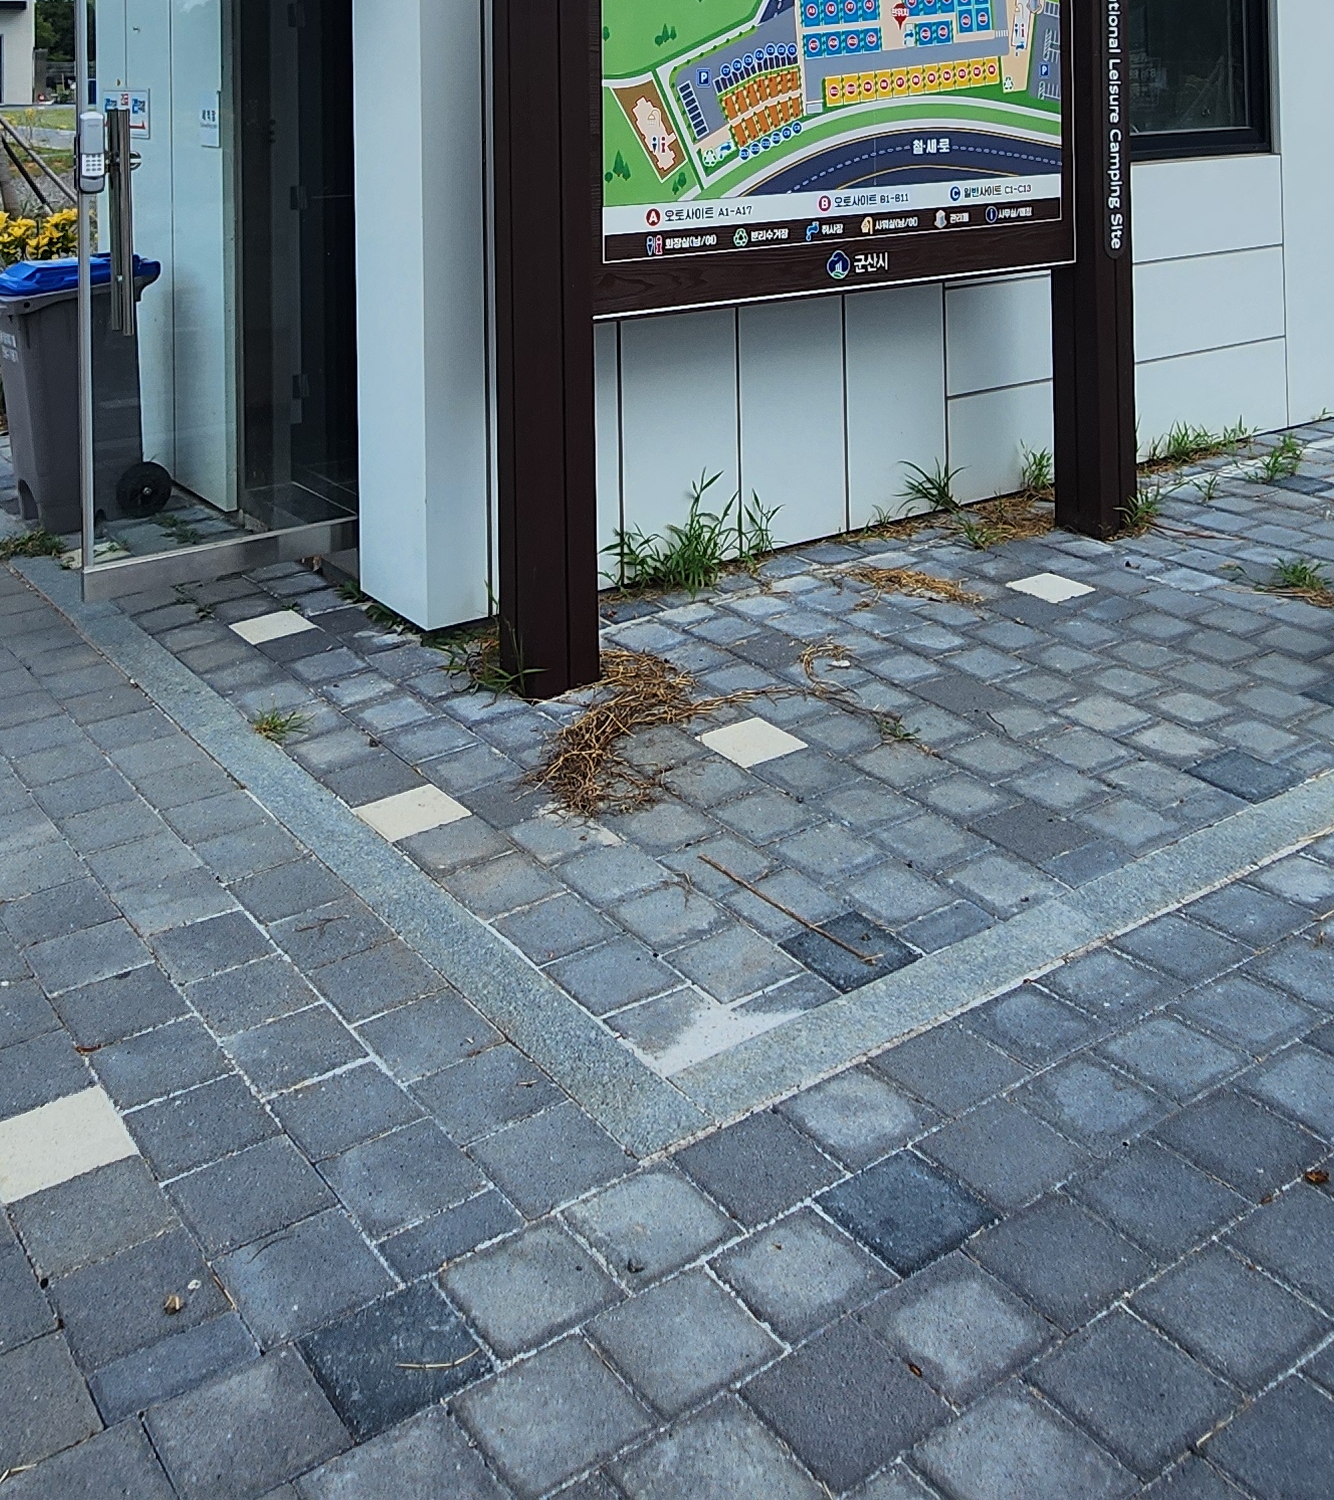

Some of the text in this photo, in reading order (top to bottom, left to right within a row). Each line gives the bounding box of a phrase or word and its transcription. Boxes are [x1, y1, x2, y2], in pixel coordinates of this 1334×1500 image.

[1108, 59, 1122, 124] Leisure
[1106, 128, 1123, 209] Camping
[834, 194, 878, 208] 오토사이트
[880, 193, 909, 204] B1-B11
[963, 185, 1003, 199] 일반사이트
[1004, 184, 1033, 195] C1-C13
[664, 206, 714, 222] 오토사이트
[718, 205, 753, 217] A1-A17
[750, 228, 789, 242] 분리수거장
[1110, 213, 1124, 250] Site
[853, 251, 889, 274] 군산시
